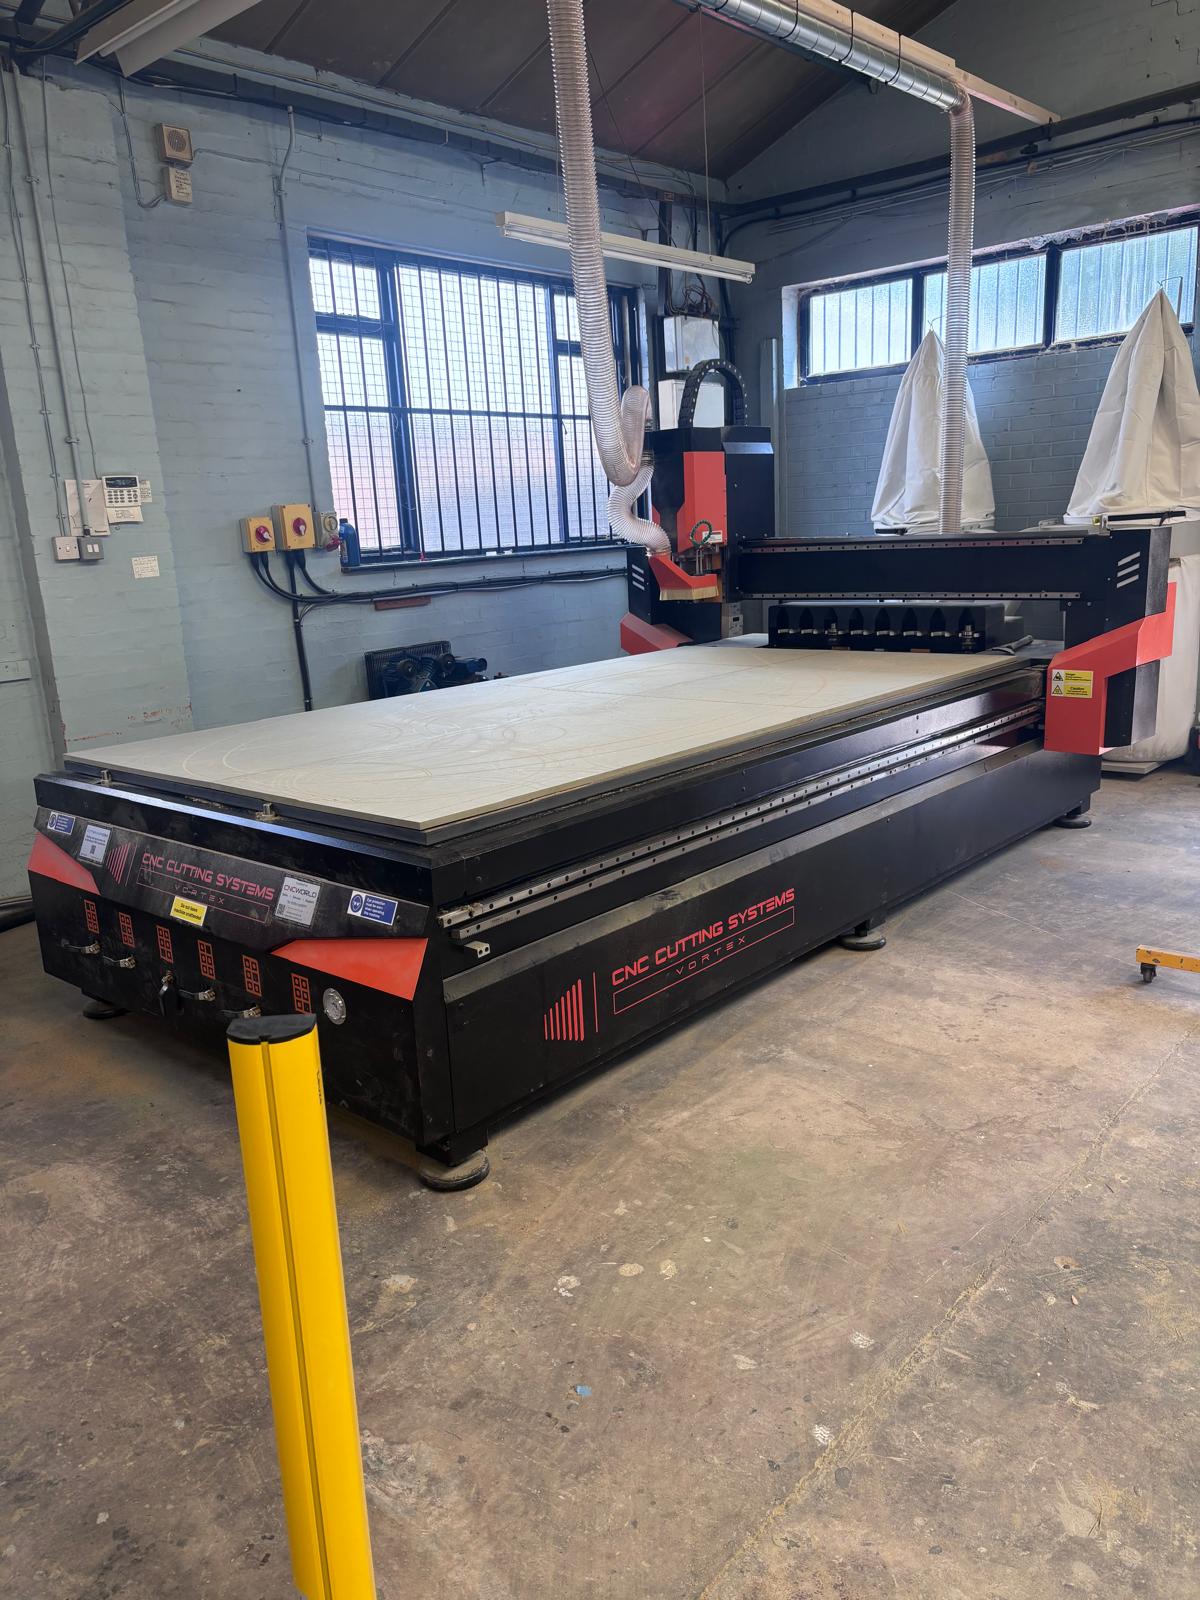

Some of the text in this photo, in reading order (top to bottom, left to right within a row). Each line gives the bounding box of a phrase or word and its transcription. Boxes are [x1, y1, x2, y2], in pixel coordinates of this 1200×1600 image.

[142, 853, 165, 868] CNC
[166, 860, 213, 883] CUTTING
[216, 873, 275, 900] SYSTEMS
[175, 885, 224, 904] VORTEX
[283, 884, 317, 898] CNCWORLD
[612, 888, 795, 986] CNC CUTTING SYSTEMS
[675, 936, 746, 975] VORTEX
